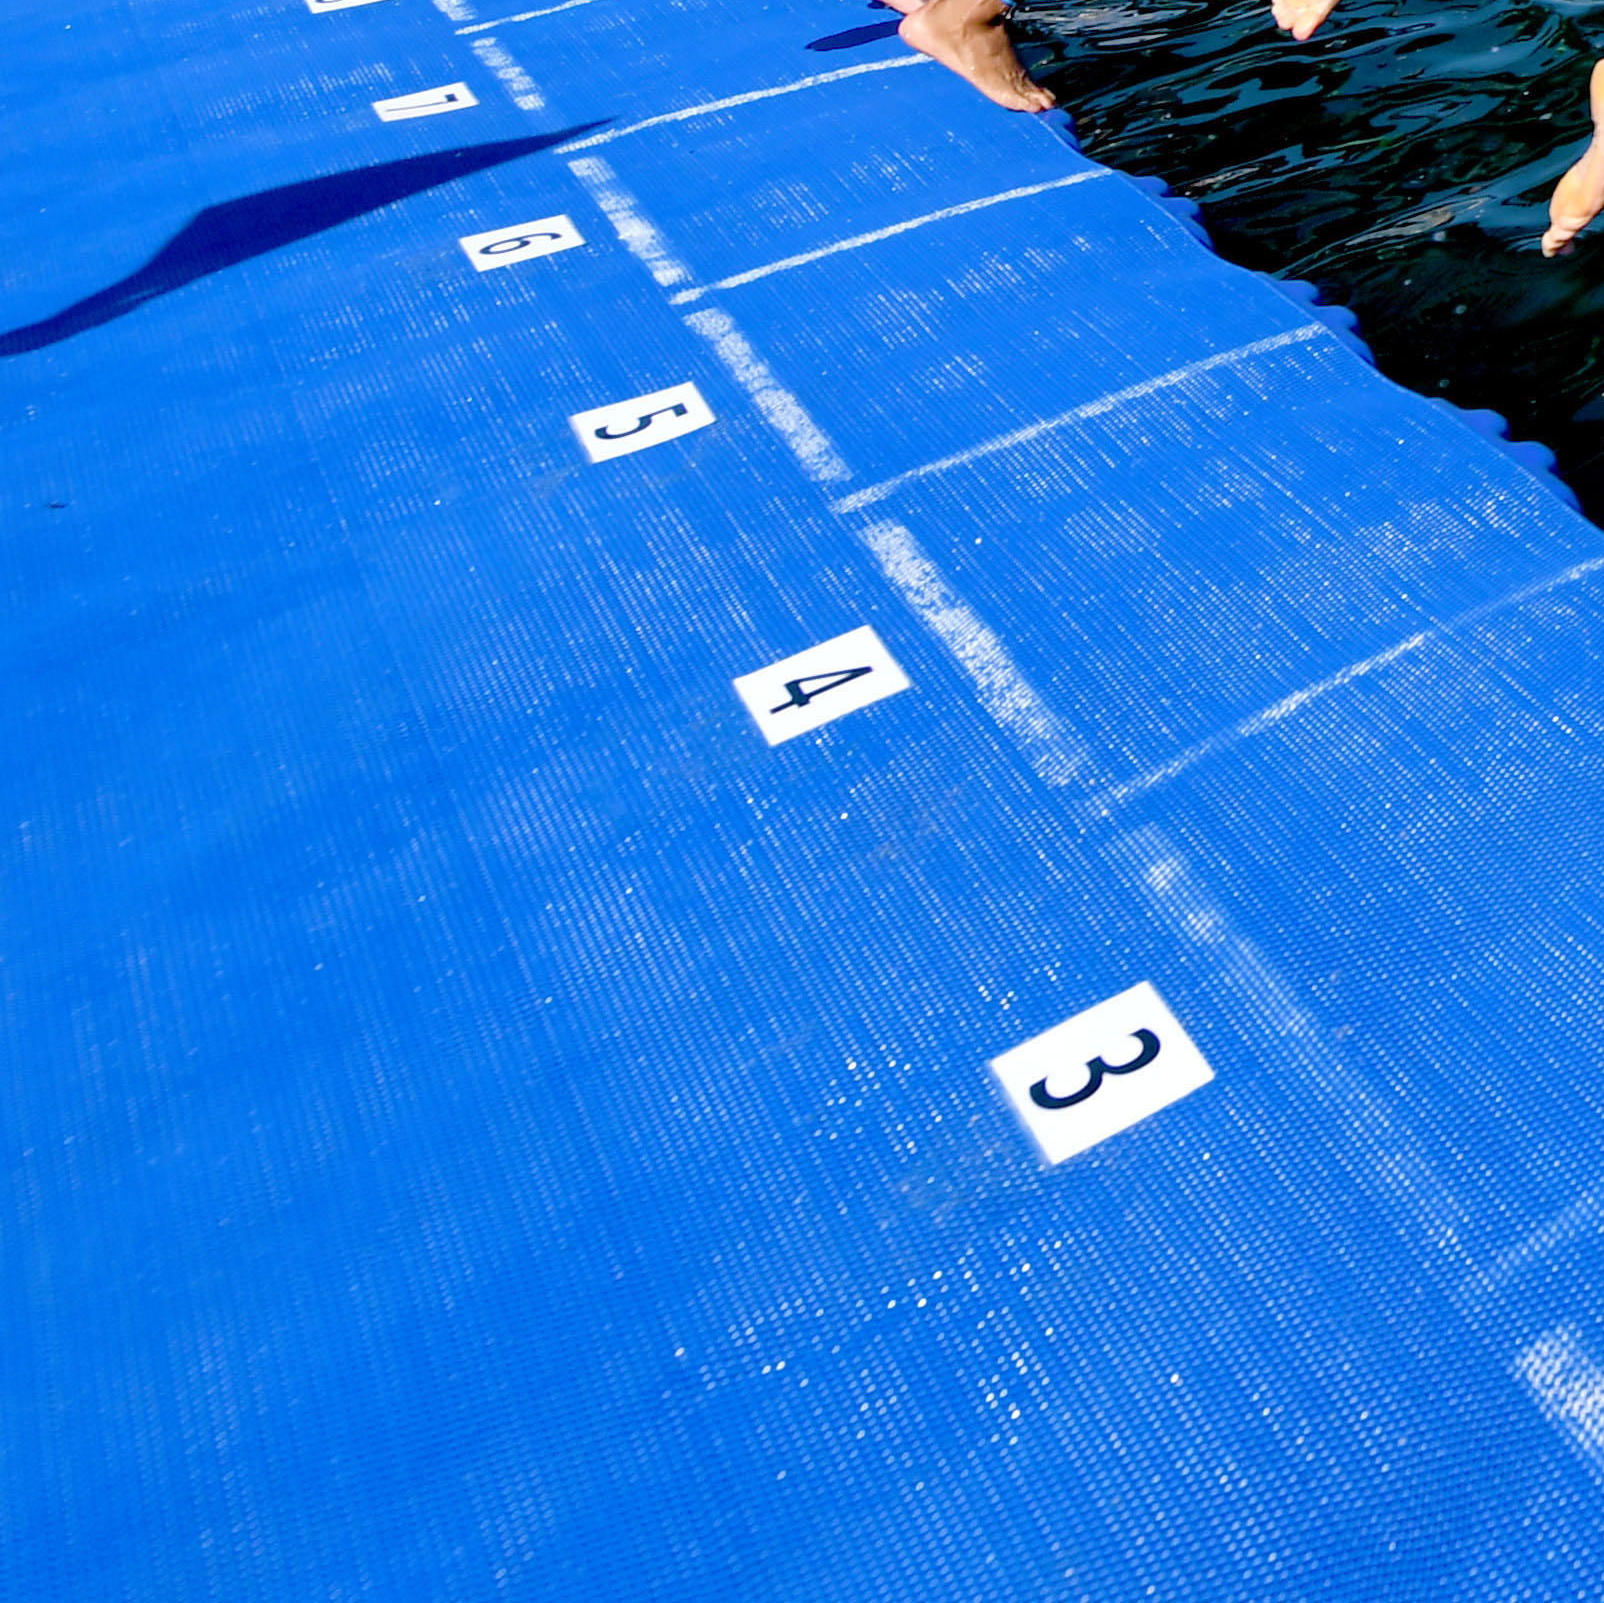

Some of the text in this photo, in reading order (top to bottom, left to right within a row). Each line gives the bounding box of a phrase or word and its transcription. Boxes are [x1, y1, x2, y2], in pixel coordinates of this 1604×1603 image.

[386, 92, 458, 113] 7
[479, 232, 562, 256] 6
[594, 403, 689, 441] 5
[769, 666, 873, 715] 4
[1028, 1027, 1161, 1111] 3
